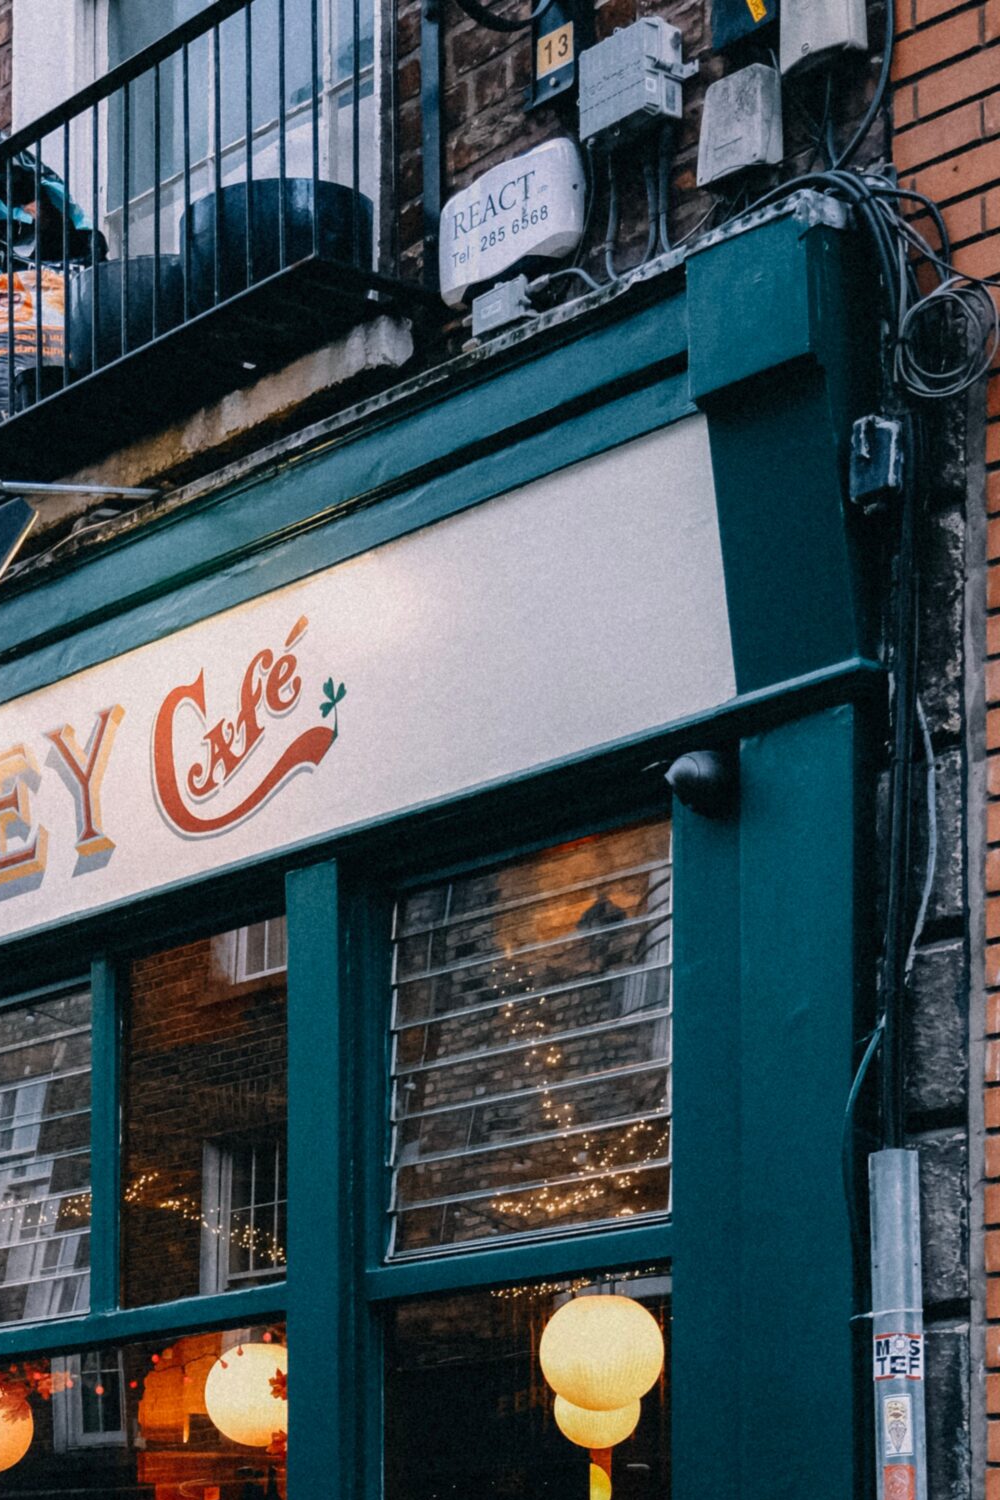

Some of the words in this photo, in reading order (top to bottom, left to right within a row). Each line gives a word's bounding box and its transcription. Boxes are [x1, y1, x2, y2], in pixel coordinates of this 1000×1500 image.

[544, 33, 569, 65] 13
[452, 170, 536, 241] REACT
[480, 226, 506, 252] 285
[511, 205, 549, 235] 6568
